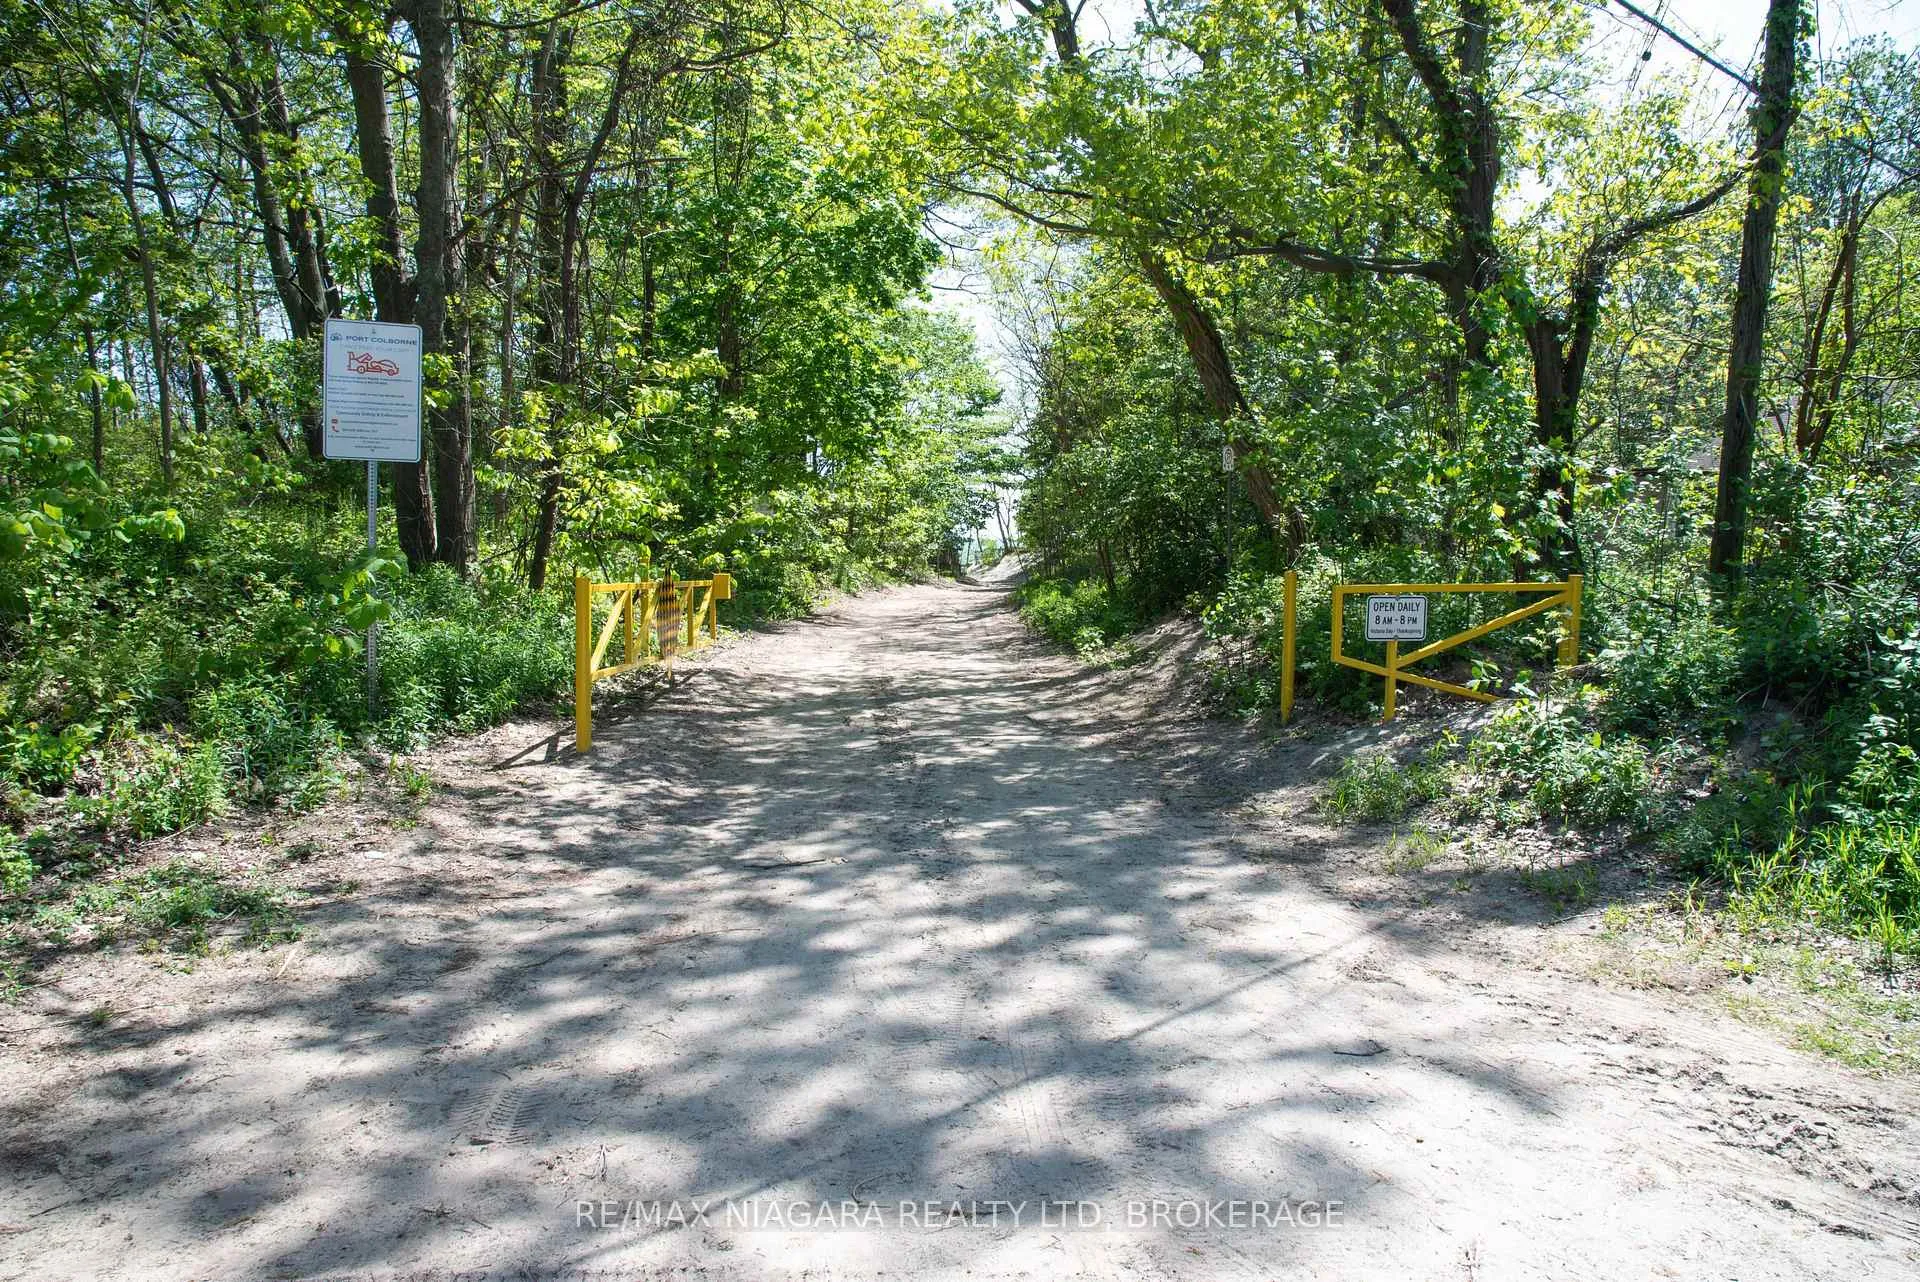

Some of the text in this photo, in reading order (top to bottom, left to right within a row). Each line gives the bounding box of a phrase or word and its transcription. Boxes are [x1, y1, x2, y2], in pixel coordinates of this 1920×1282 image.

[370, 337, 418, 345] COLBORNE
[1373, 602, 1421, 612] OPEN DAILY
[1375, 615, 1381, 625] 8
[1382, 616, 1393, 625] AM
[1400, 615, 1406, 625] 8
[1407, 616, 1418, 625] PM
